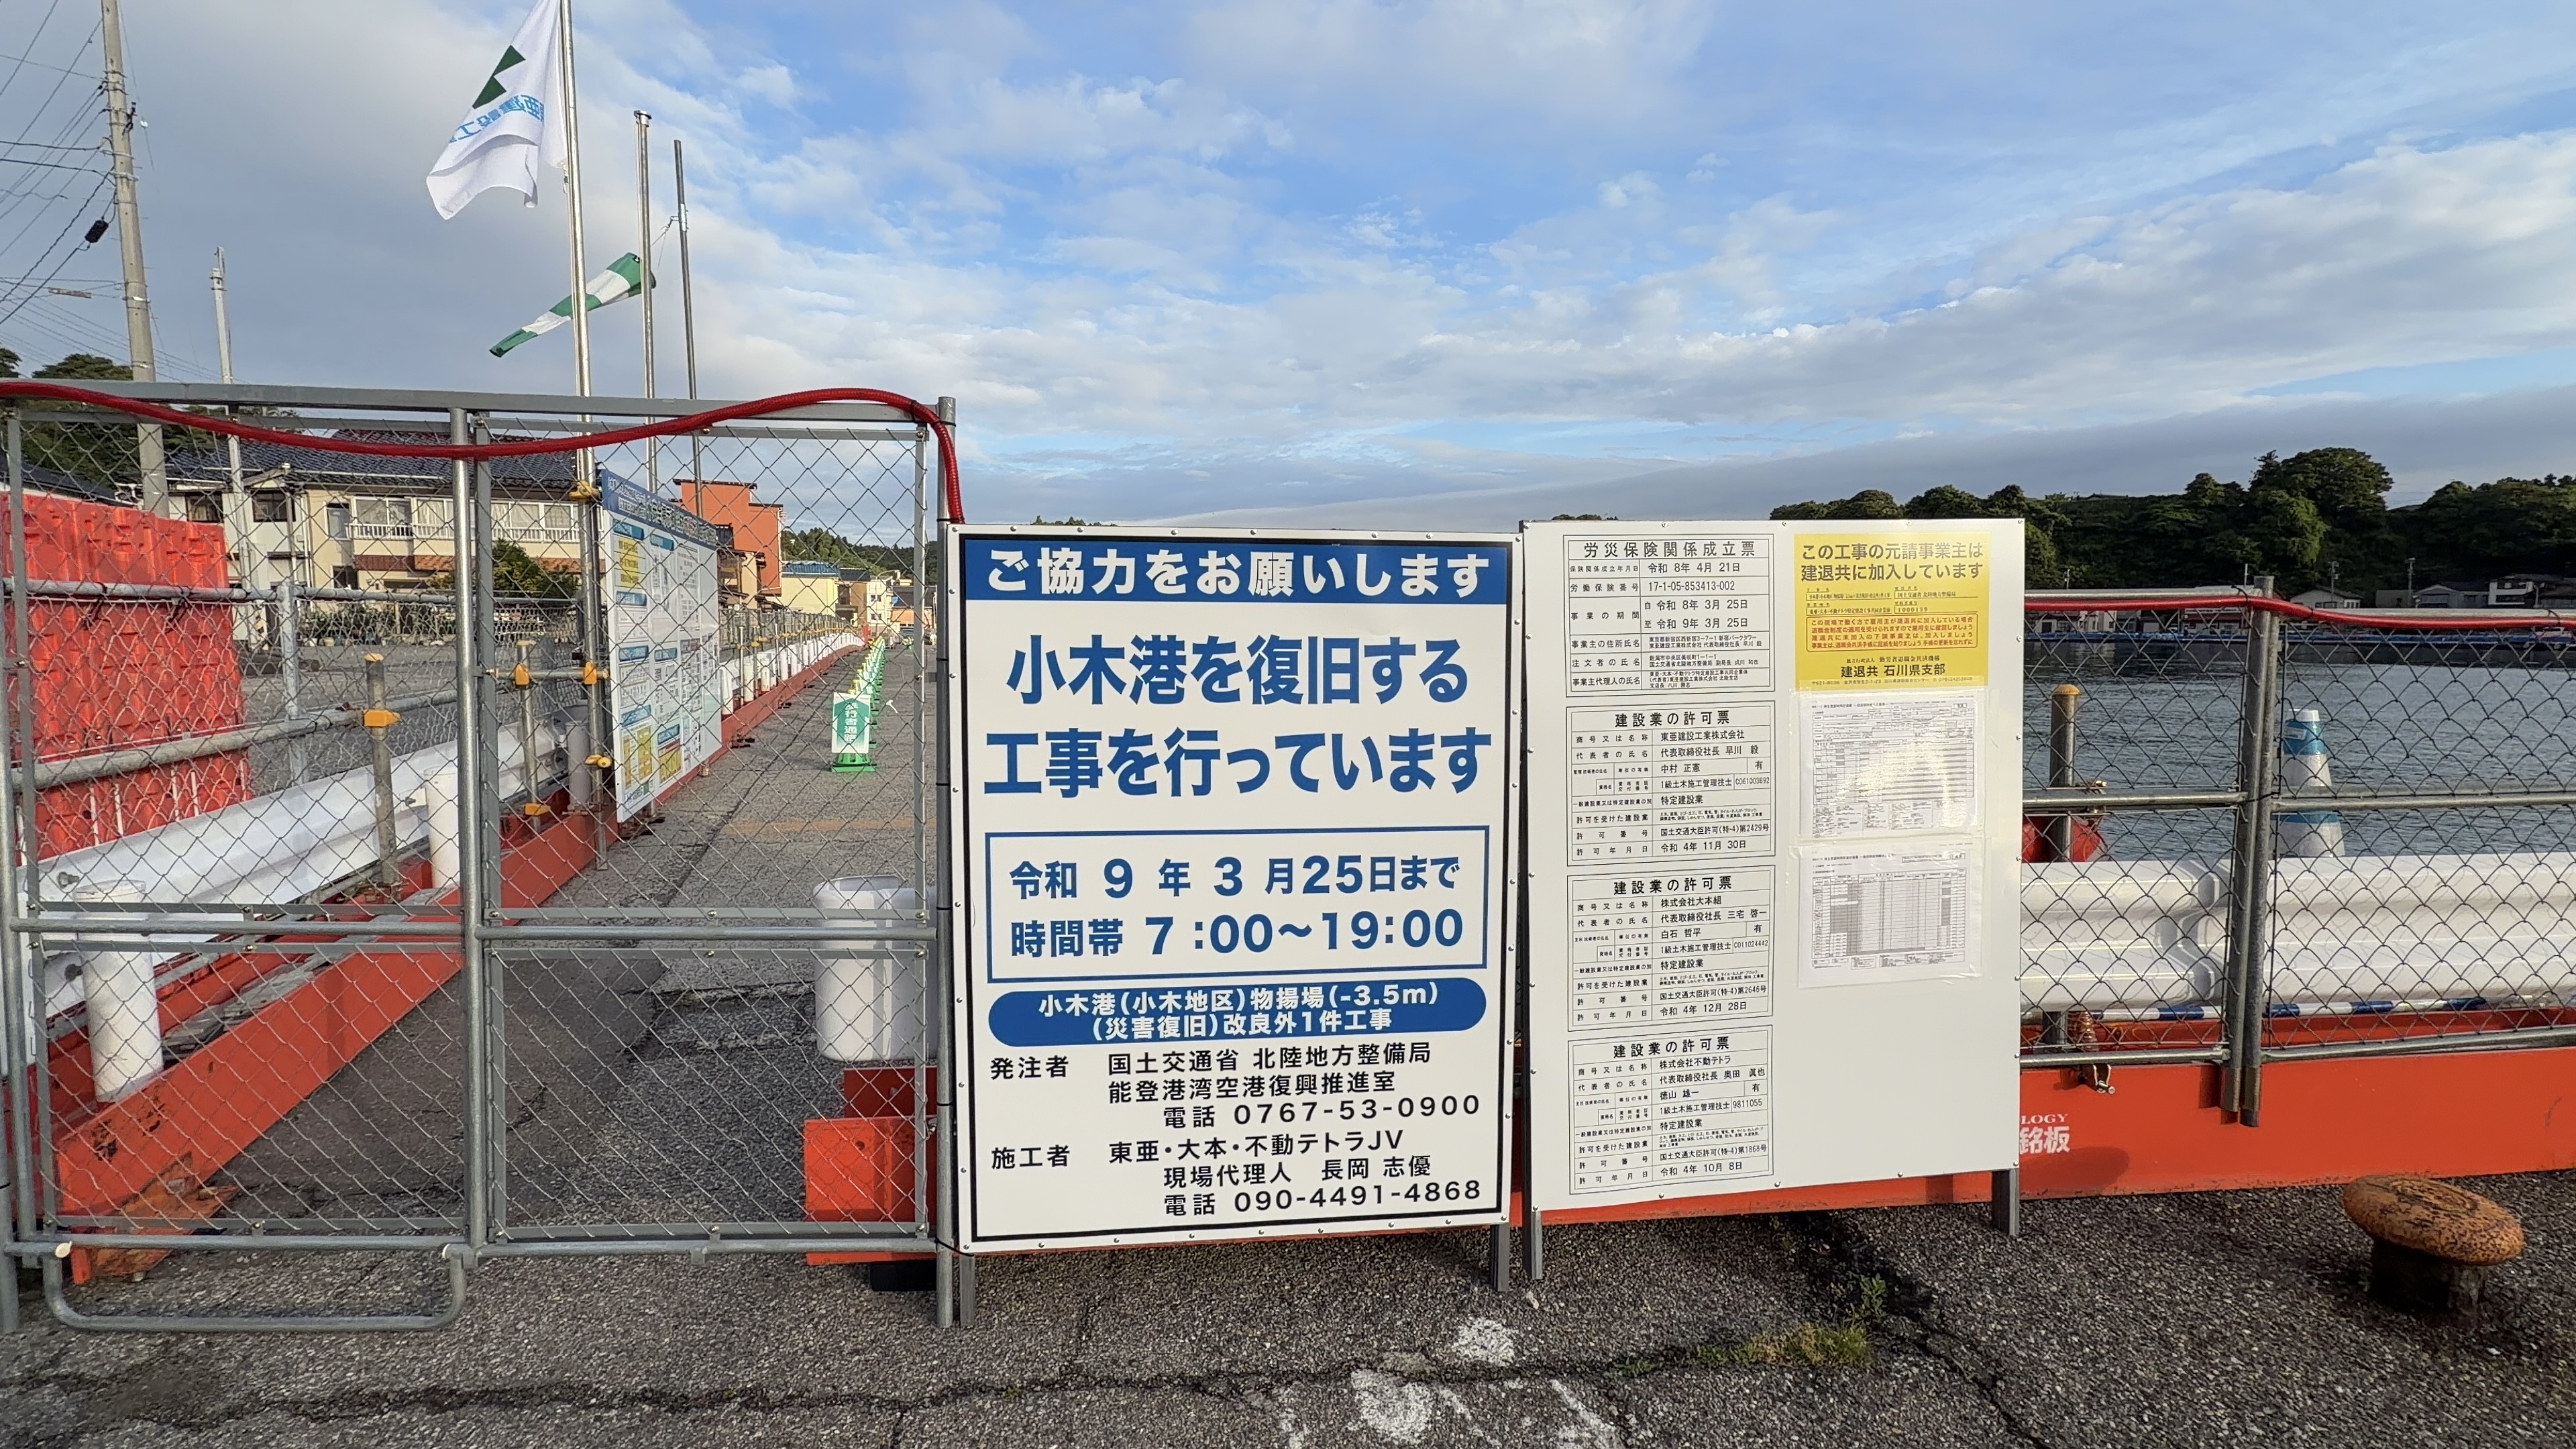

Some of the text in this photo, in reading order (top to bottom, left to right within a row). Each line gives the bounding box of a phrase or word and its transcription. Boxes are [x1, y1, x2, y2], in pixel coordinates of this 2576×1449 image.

[1584, 541, 1755, 558] 労災保険関係成立票
[1803, 542, 1982, 560] この工事の元請事業主は
[987, 548, 1490, 598] ご協力をお願いします
[1648, 562, 1739, 573] 令和 8年 4月 21日
[1801, 563, 1982, 582] 建退共に加入しています
[1648, 581, 1735, 592] 17-1-05-853413-002
[1657, 600, 1676, 610] 令和
[1682, 600, 1698, 610] 8年
[1705, 600, 1719, 610] 3月
[1727, 599, 1748, 609] 25日
[1571, 612, 1640, 620] 事業の期間
[1657, 619, 1676, 629] 令和
[1682, 618, 1699, 629] 9年
[1705, 618, 1720, 628] 3月
[1727, 618, 1748, 627] 25日
[1572, 639, 1640, 648] 事業主の住所氏名
[1005, 633, 1470, 705] 小木港を復旧する
[1572, 658, 1640, 667] 注文者の氏名
[1841, 663, 1945, 677] 建退共 石川県支部
[1572, 676, 1640, 686] 事業主代理人の氏名
[1615, 710, 1730, 728] 建設業の許可票
[1661, 730, 1744, 741] 東亜建設工業株式会社
[1661, 746, 1719, 758] 代表取締役社長
[1726, 746, 1741, 755] 早川
[983, 726, 1492, 799] 工事を行っています
[1661, 764, 1677, 773] 中村
[1755, 761, 1763, 770] 有
[1661, 795, 1703, 805] 特定建設業
[1661, 840, 1746, 853] 令和 4年 11月 30日
[1010, 860, 1077, 900] 令和
[1613, 876, 1732, 895] 建設業の許可票
[1661, 896, 1721, 908] 株式会社大本組
[1661, 911, 1721, 923] 代表取締役社長
[1728, 910, 1744, 919] 三宅
[1661, 930, 1677, 939] 白石
[1754, 924, 1762, 933] 有
[1010, 920, 1124, 958] 時間帯
[1660, 959, 1704, 969] 特定建設業
[1660, 1002, 1746, 1016] 令和 4年 12月 28日
[1613, 1036, 1729, 1058] 建設業の許可票
[1108, 1041, 1431, 1075] 国土交通省 北陸地方整備局
[1660, 1056, 1731, 1069] 株式会社不動テトラ
[990, 1056, 1069, 1081] 発注者
[1660, 1071, 1717, 1085] 代表取締役社長
[1108, 1071, 1396, 1104] 能登港湾空港復興推進室
[1752, 1083, 1760, 1092] 有
[1733, 1099, 1762, 1108] 9811055
[1163, 1095, 1480, 1129] 電話 0767-53-0900
[1660, 1119, 1703, 1130] 特定建設業
[2020, 1114, 2068, 1124] LOGY
[1108, 1130, 1403, 1165] 東亜・大本・不動テトラJV
[991, 1145, 1070, 1170] 施工者
[1164, 1155, 1431, 1189] 現場代理人 長岡 志優
[1660, 1162, 1742, 1177] 令和 4年 10月 8日
[1164, 1180, 1481, 1217] 電話 090-4491-4868
